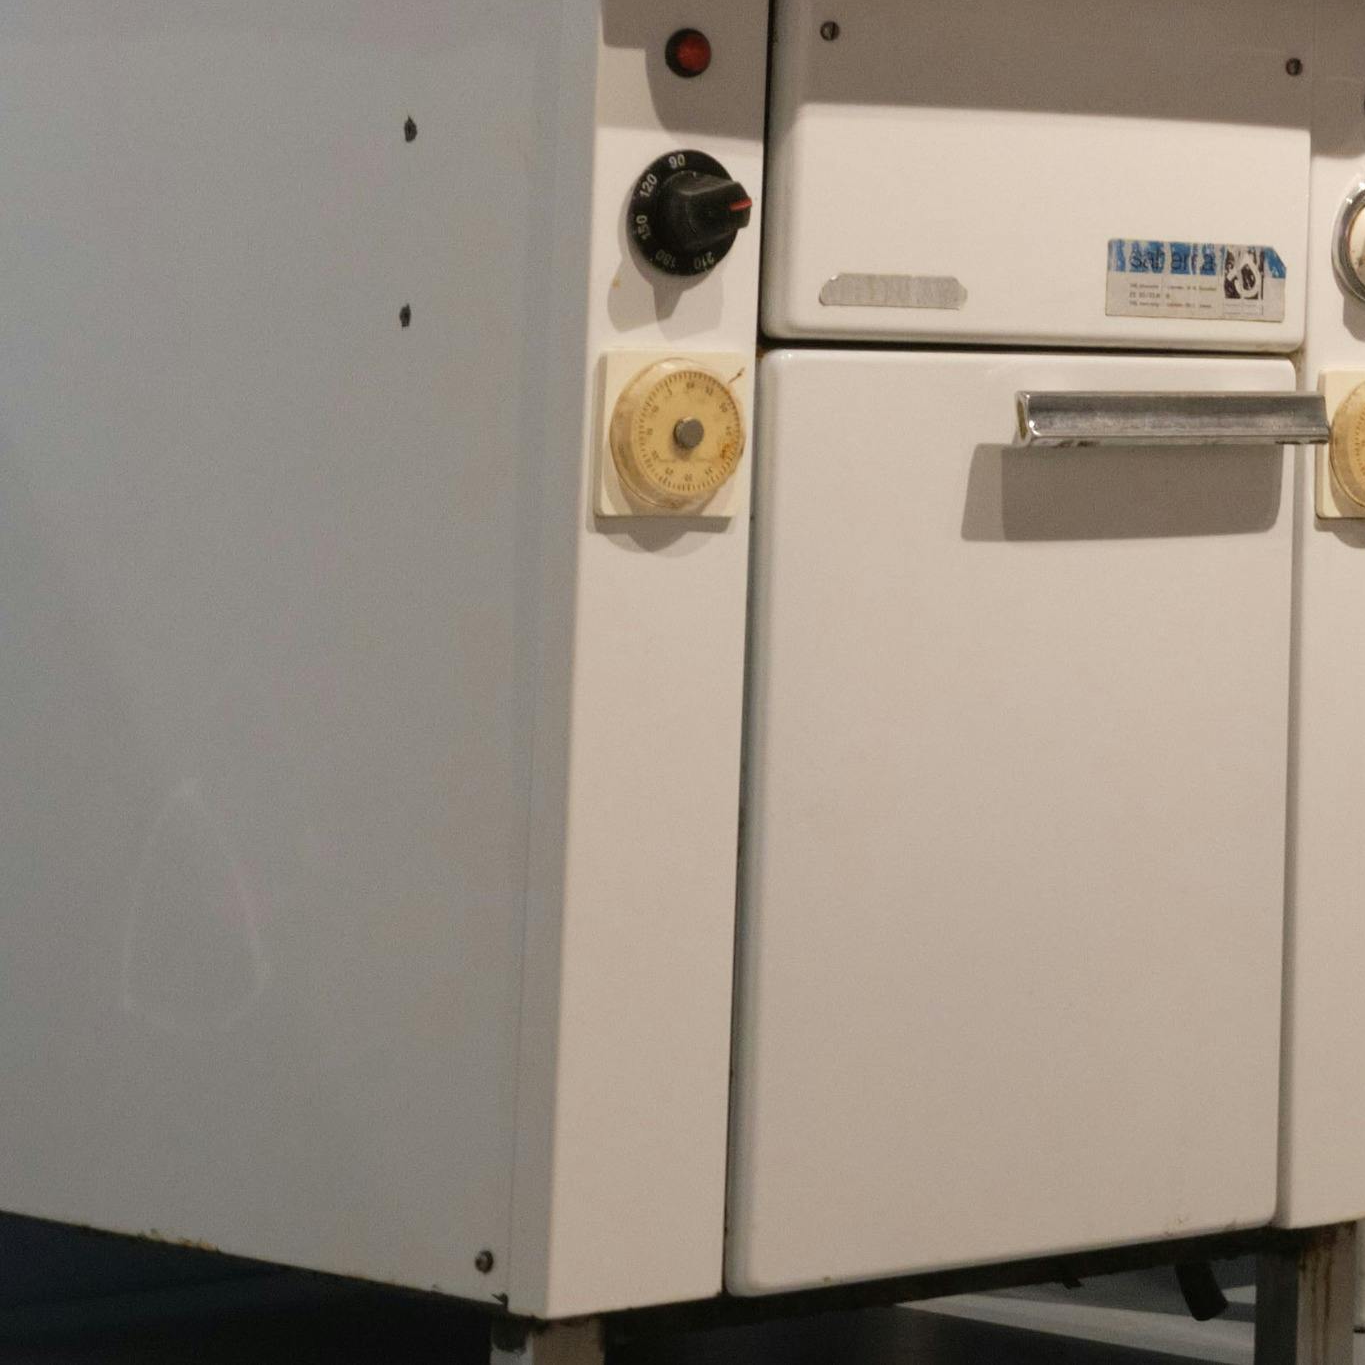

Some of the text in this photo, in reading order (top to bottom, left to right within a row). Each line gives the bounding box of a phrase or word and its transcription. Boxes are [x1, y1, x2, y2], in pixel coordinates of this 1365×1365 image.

[668, 153, 686, 169] 90
[639, 173, 658, 198] 120
[636, 214, 652, 240] 150
[693, 251, 715, 269] 210
